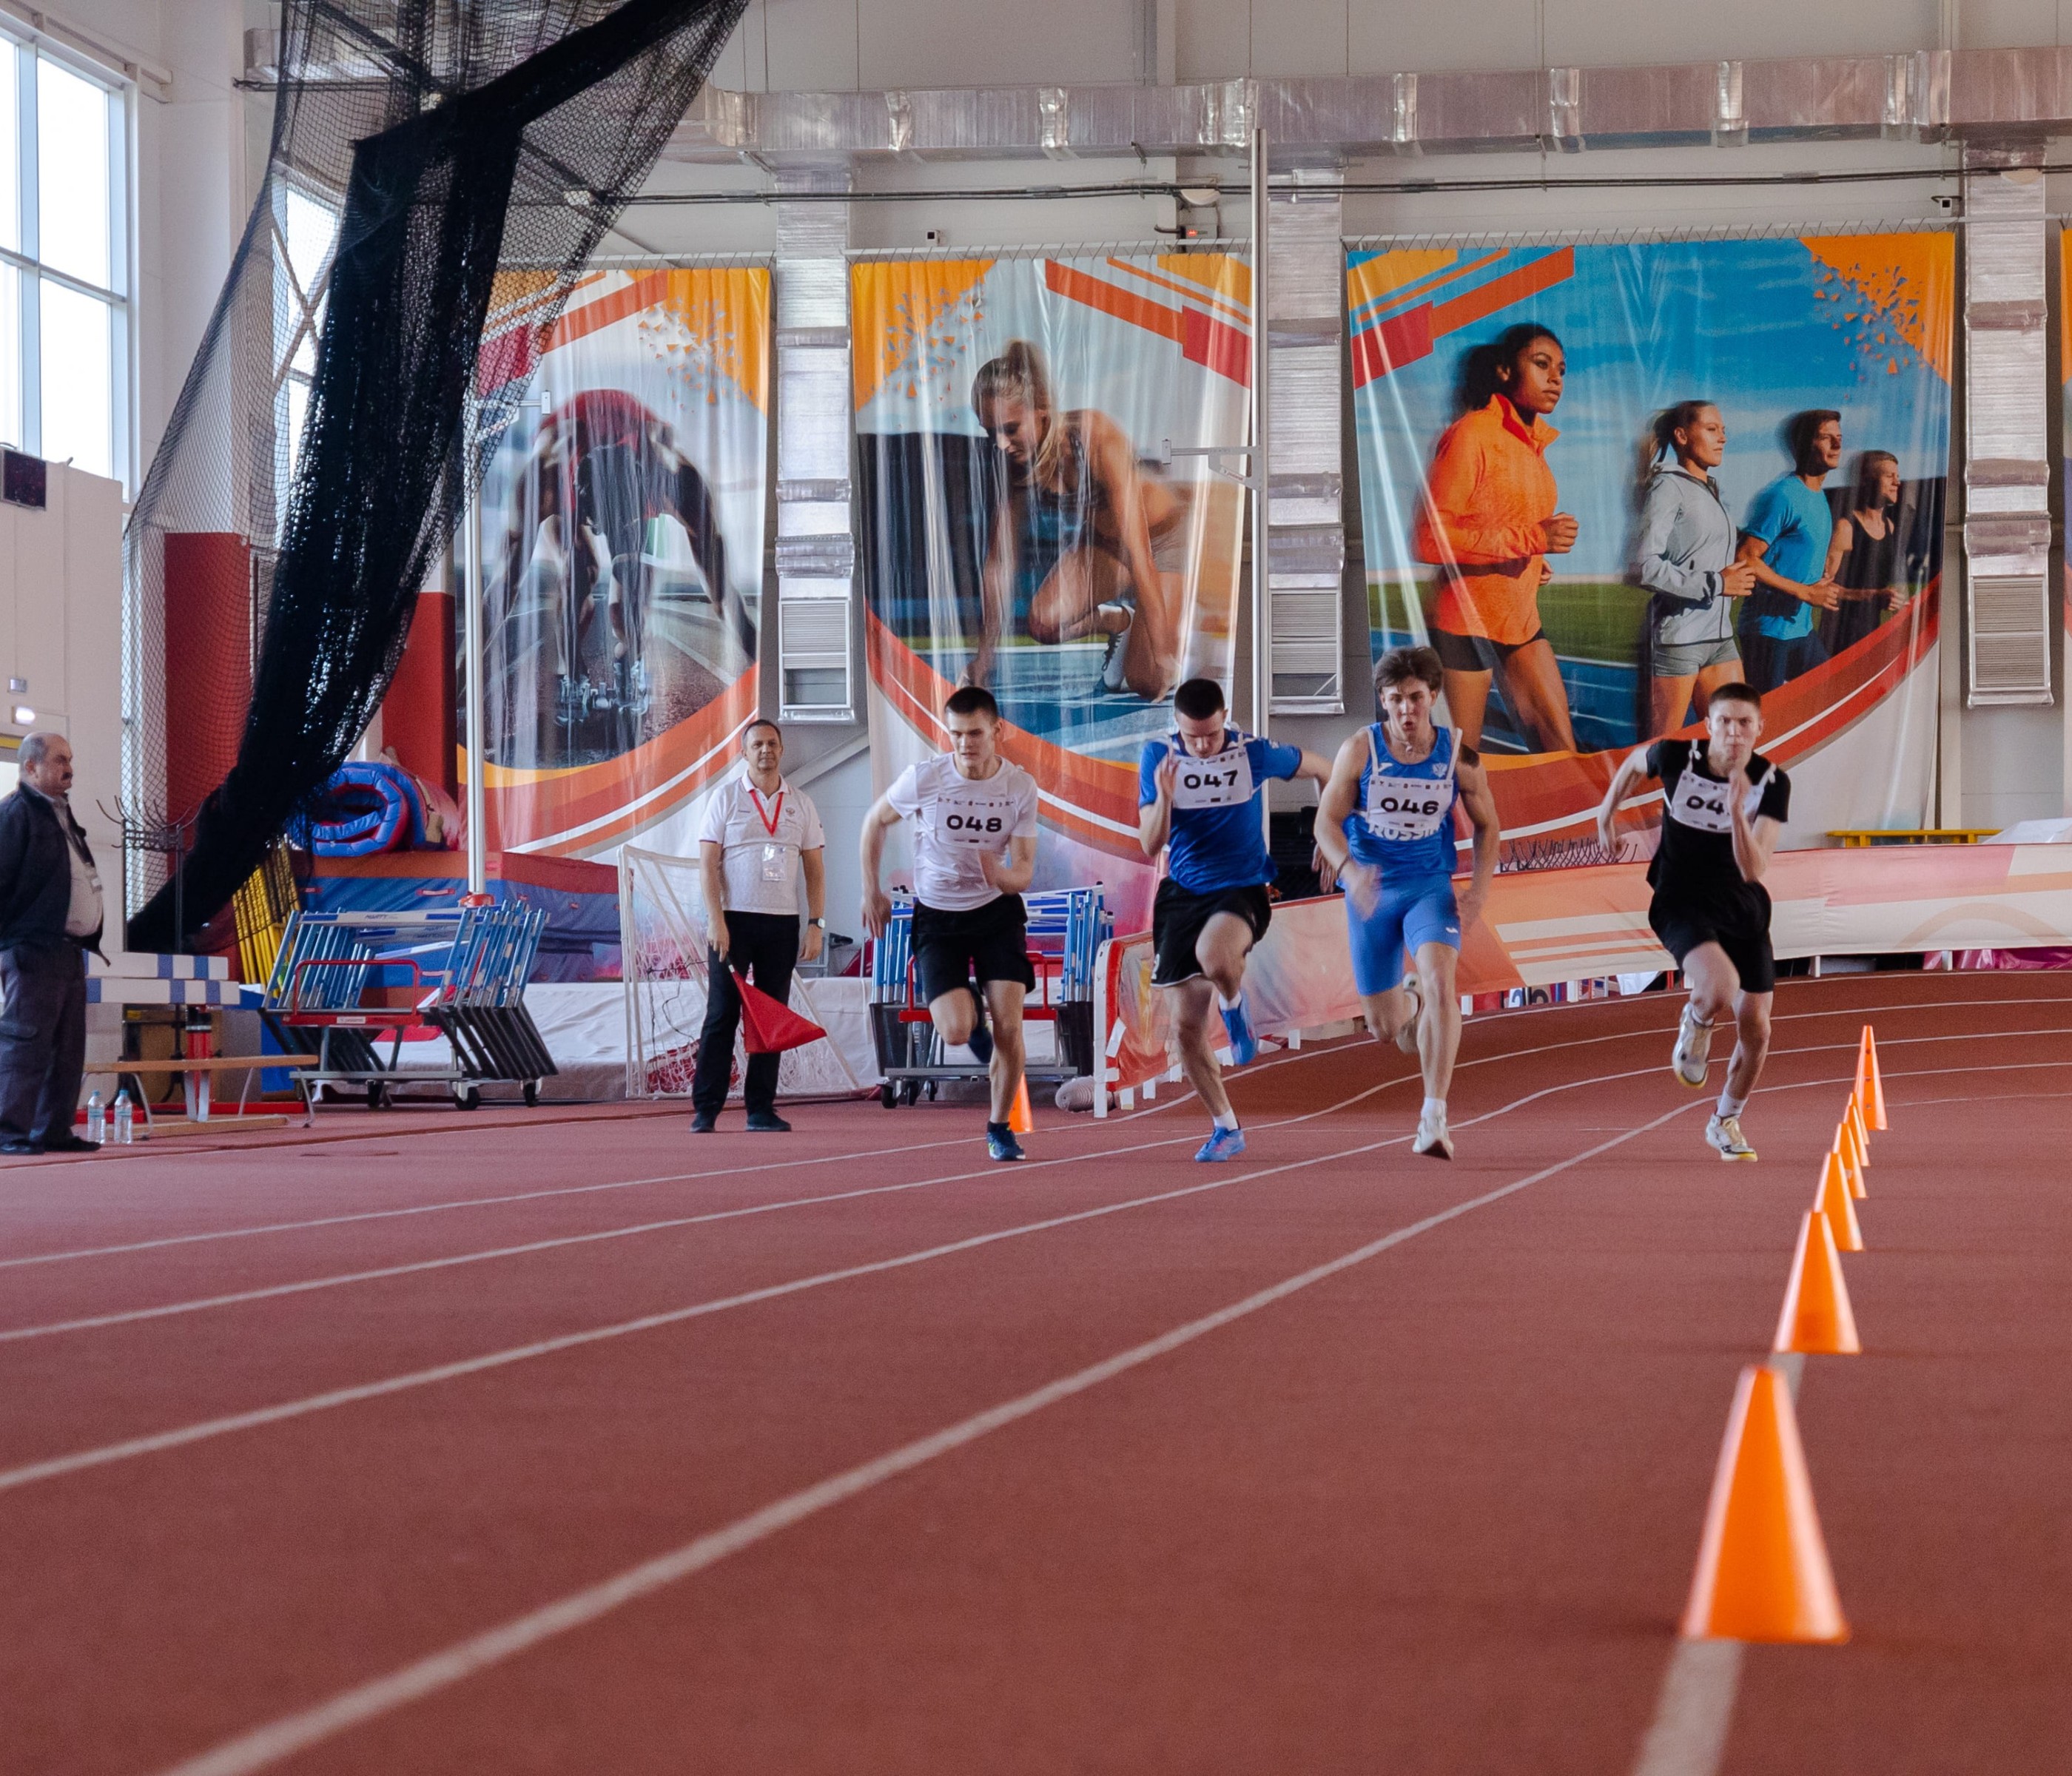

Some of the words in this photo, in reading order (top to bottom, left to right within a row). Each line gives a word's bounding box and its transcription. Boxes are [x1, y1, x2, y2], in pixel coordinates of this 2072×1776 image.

[1184, 770, 1238, 790] 047
[1381, 798, 1439, 815] 046
[1686, 796, 1731, 816] 04
[946, 815, 1002, 832] 048
